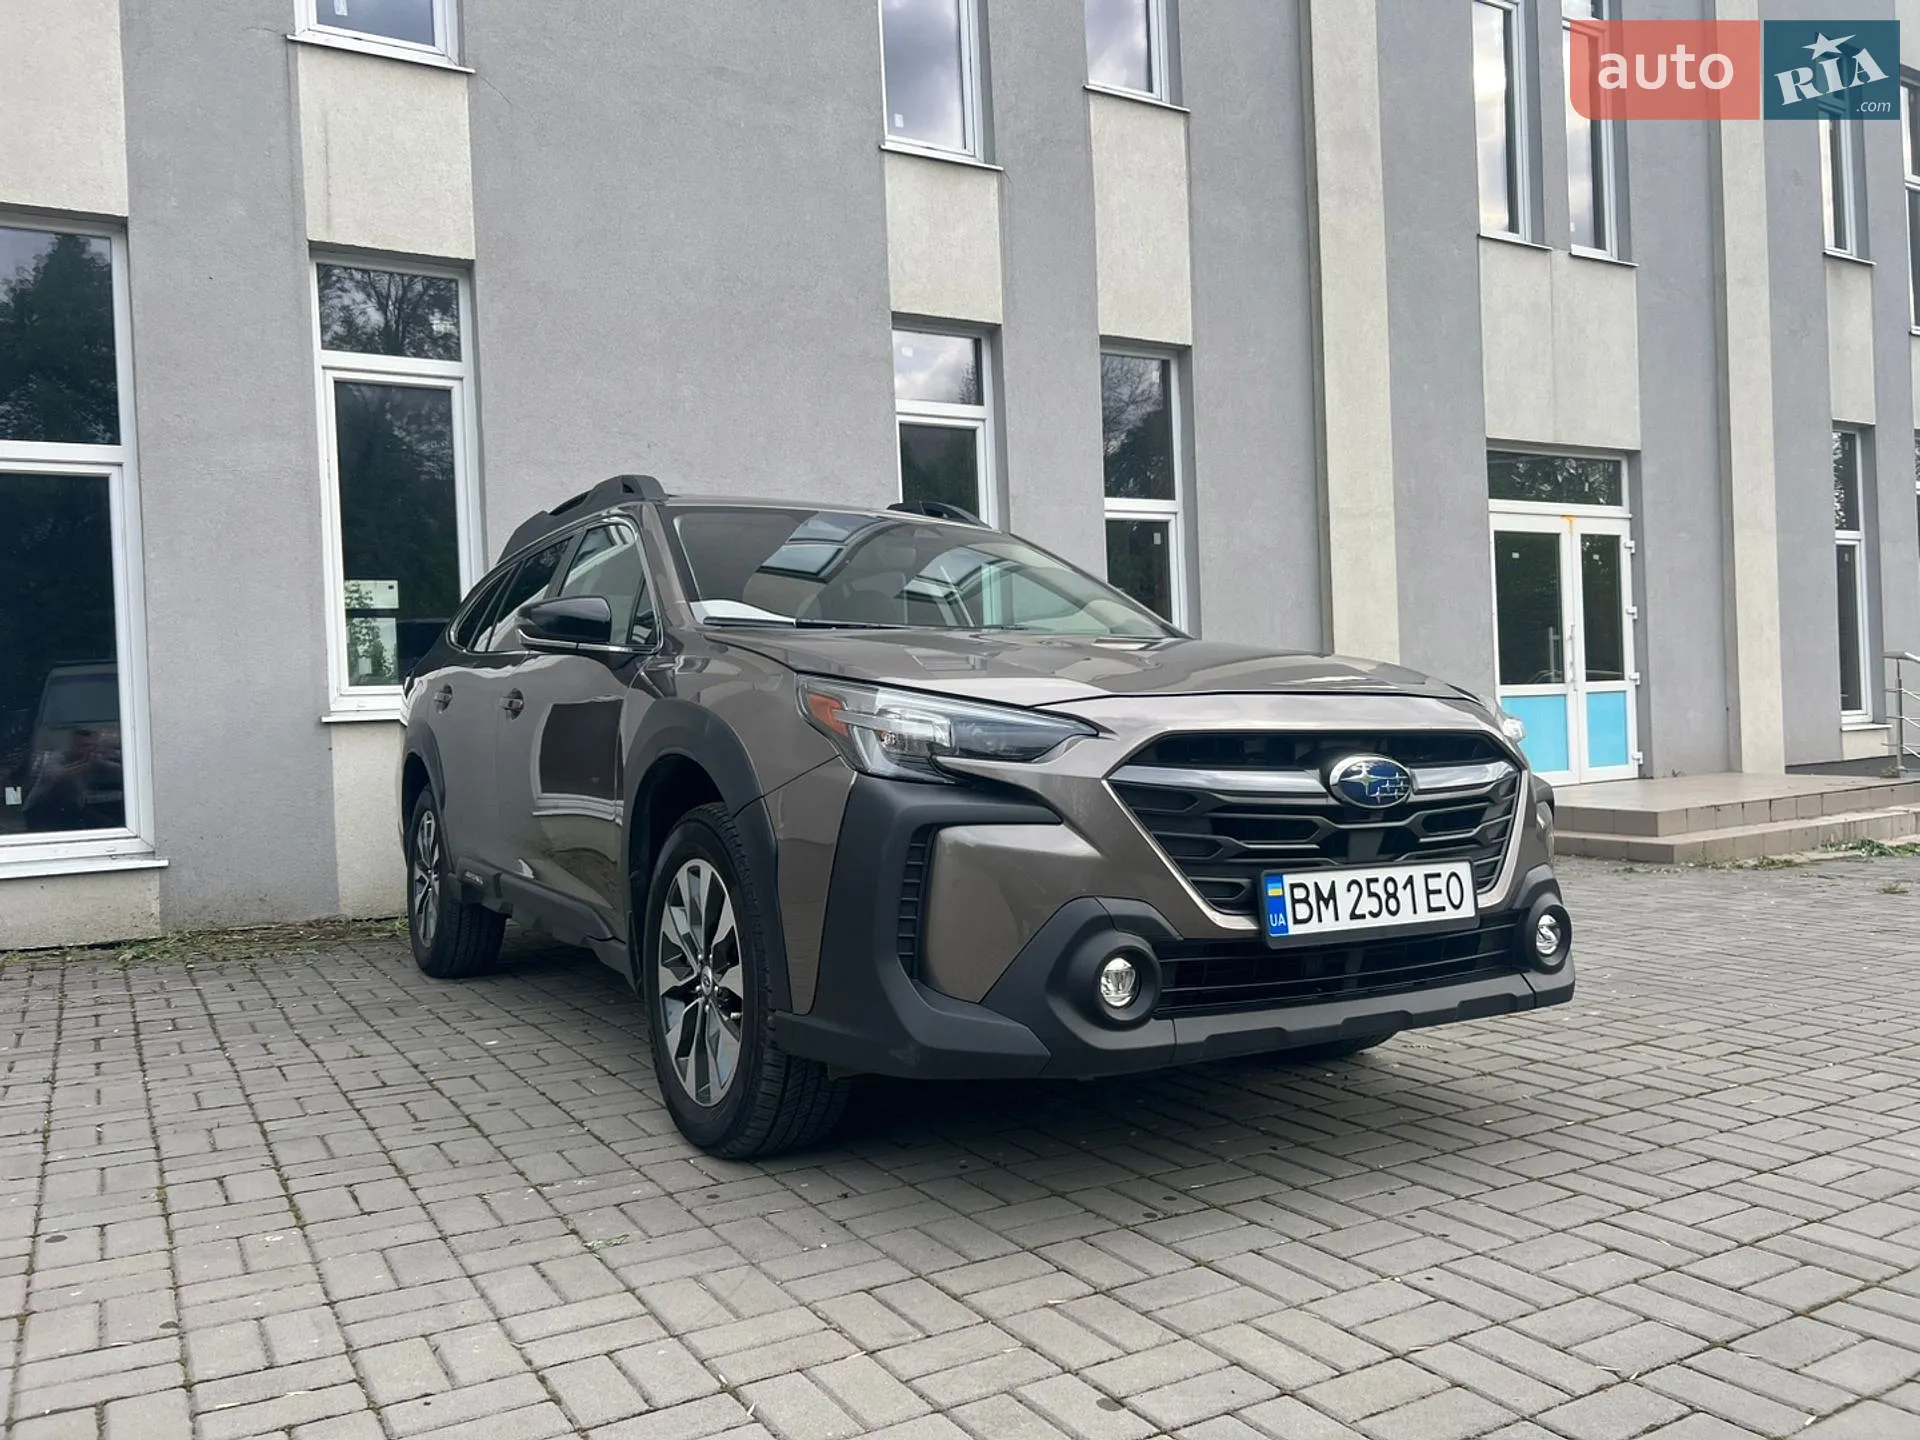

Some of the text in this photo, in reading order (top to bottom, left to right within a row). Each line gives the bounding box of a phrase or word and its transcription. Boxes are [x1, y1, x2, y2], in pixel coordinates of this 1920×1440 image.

[1289, 870, 1464, 926] BM 2581 EO
[1269, 913, 1287, 928] UA
